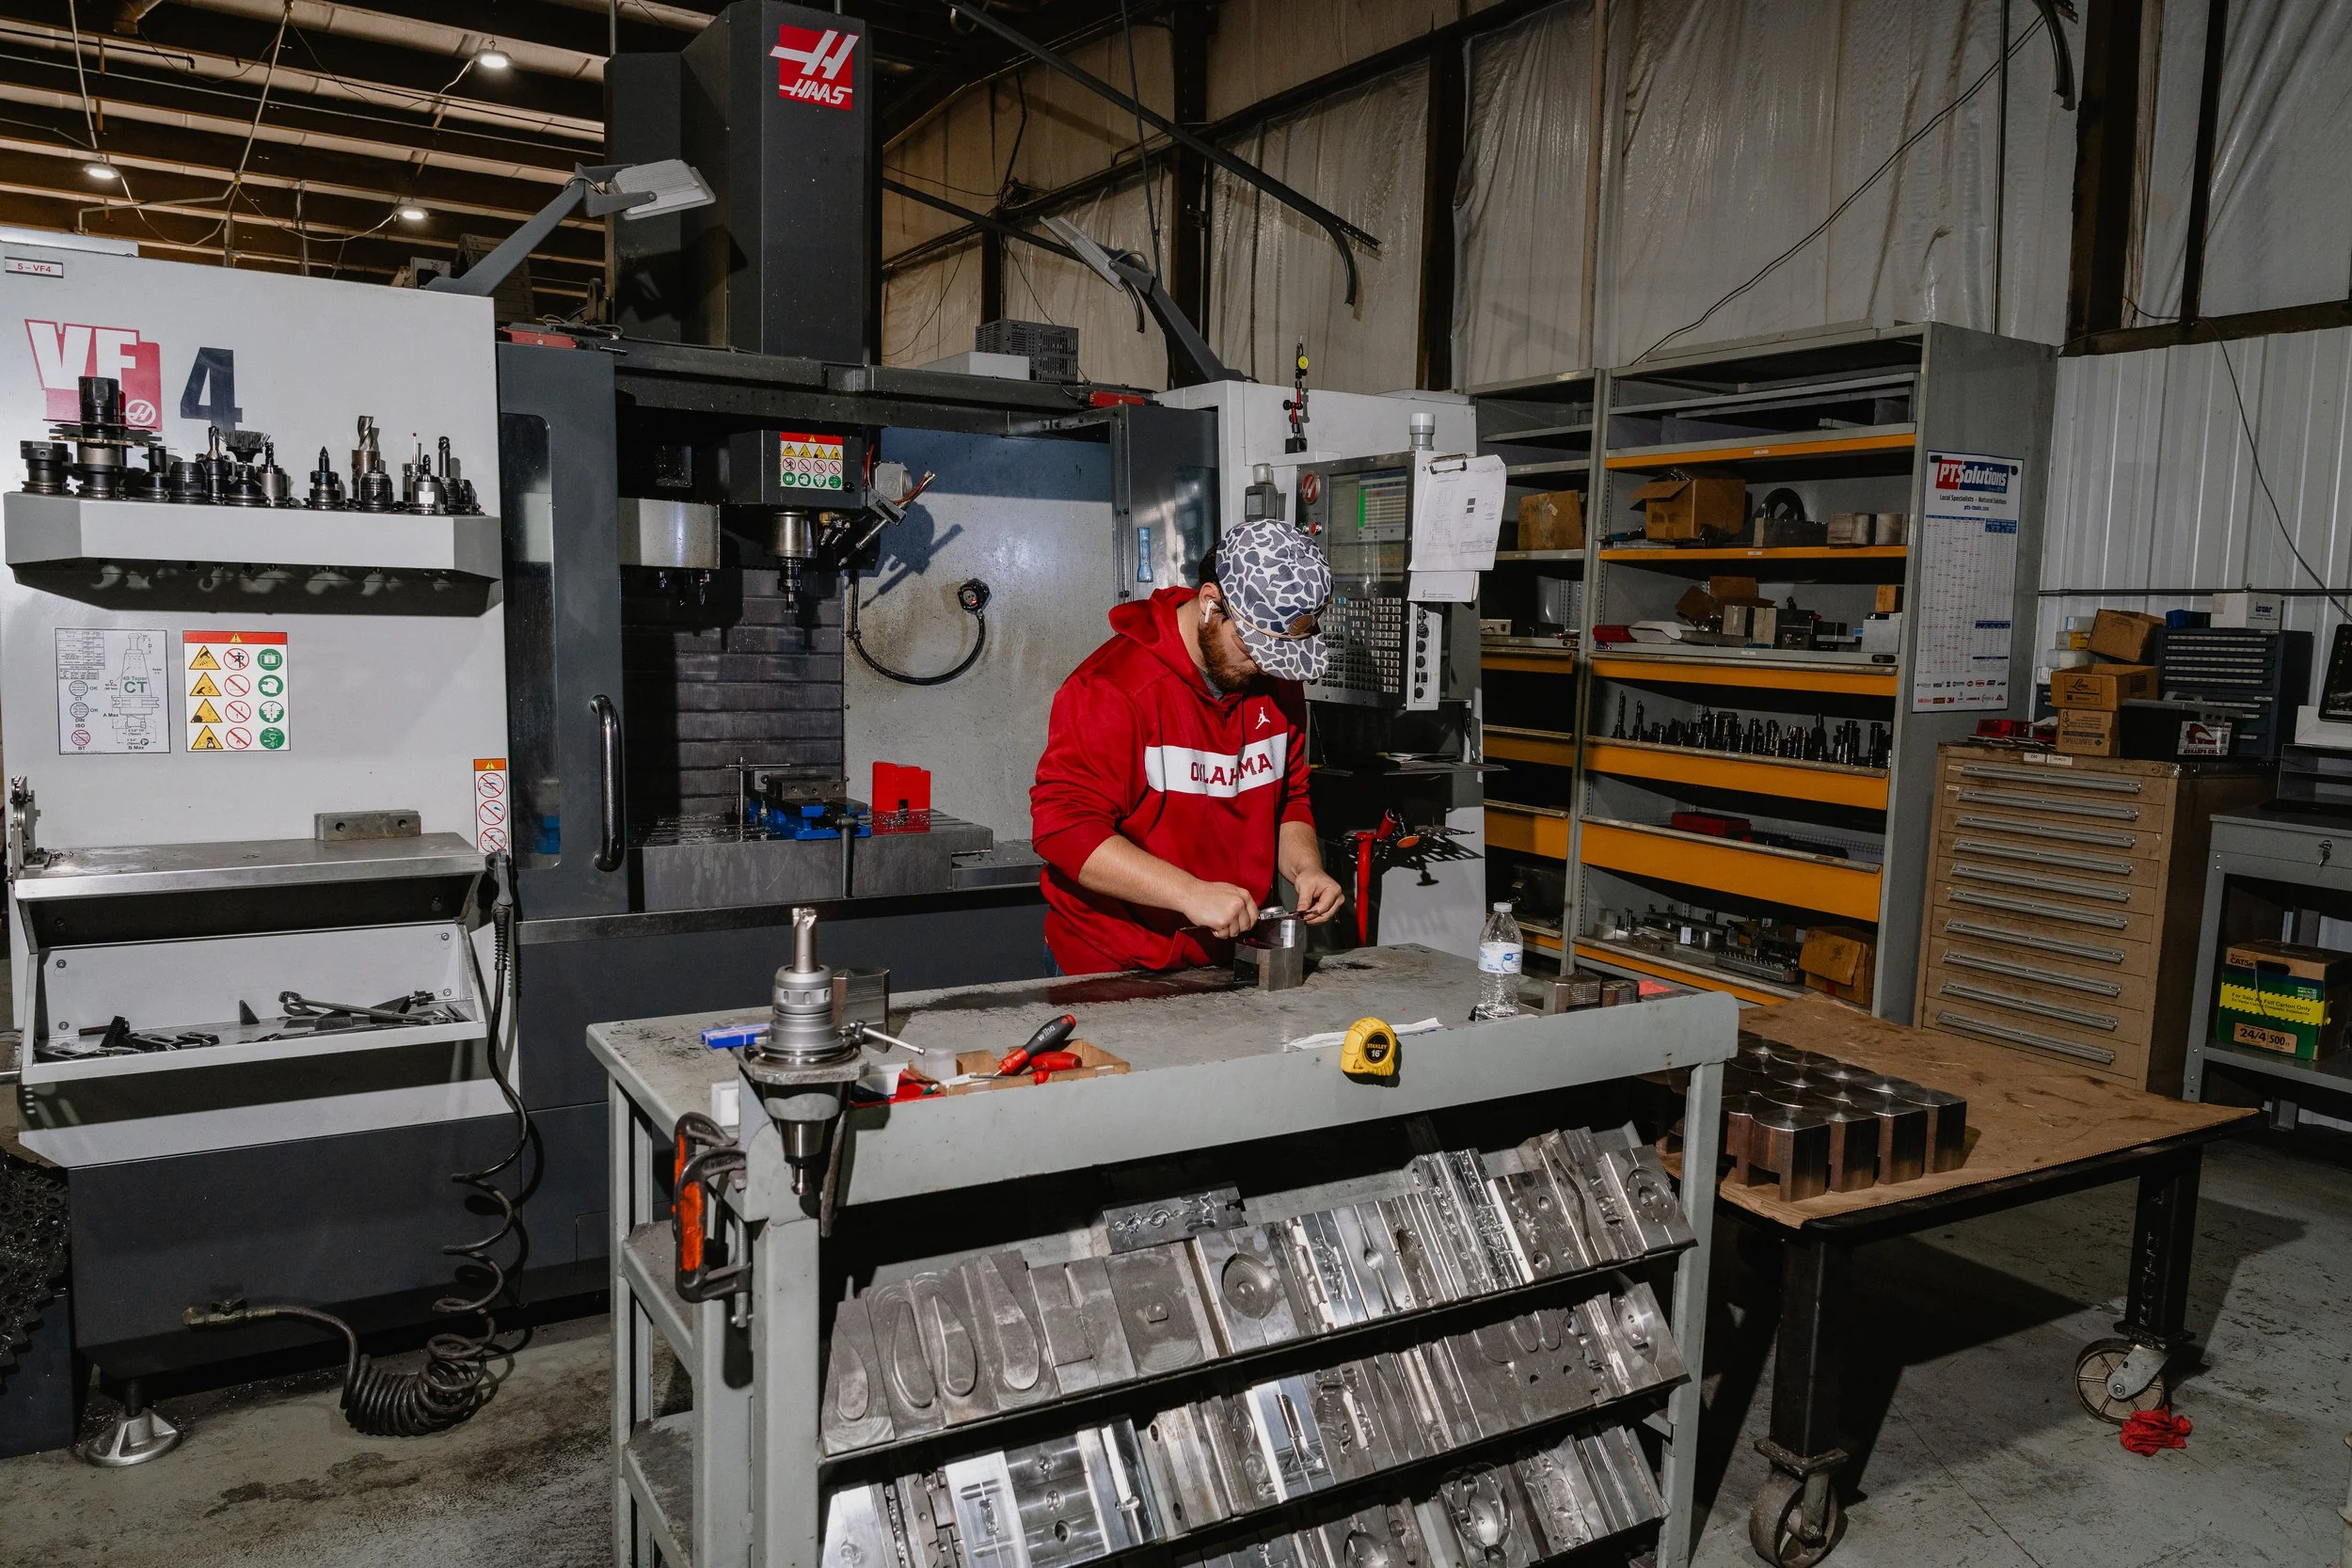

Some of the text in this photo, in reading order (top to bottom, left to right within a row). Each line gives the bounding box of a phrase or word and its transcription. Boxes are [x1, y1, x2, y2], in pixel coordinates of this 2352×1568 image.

[779, 78, 853, 104] HAAS
[33, 264, 52, 273] VF4
[24, 319, 244, 431] VF 4
[1938, 463, 2008, 486] PTSolutions
[124, 681, 148, 693] CT
[1190, 752, 1273, 786] OKLAHMA
[2230, 957, 2254, 968] CAT5e
[2276, 1001, 2296, 1009] Carton
[2296, 1004, 2312, 1012] Only
[1037, 1024, 1056, 1041] wiha
[2239, 1027, 2266, 1042] 24/4
[2269, 1034, 2285, 1046] 500
